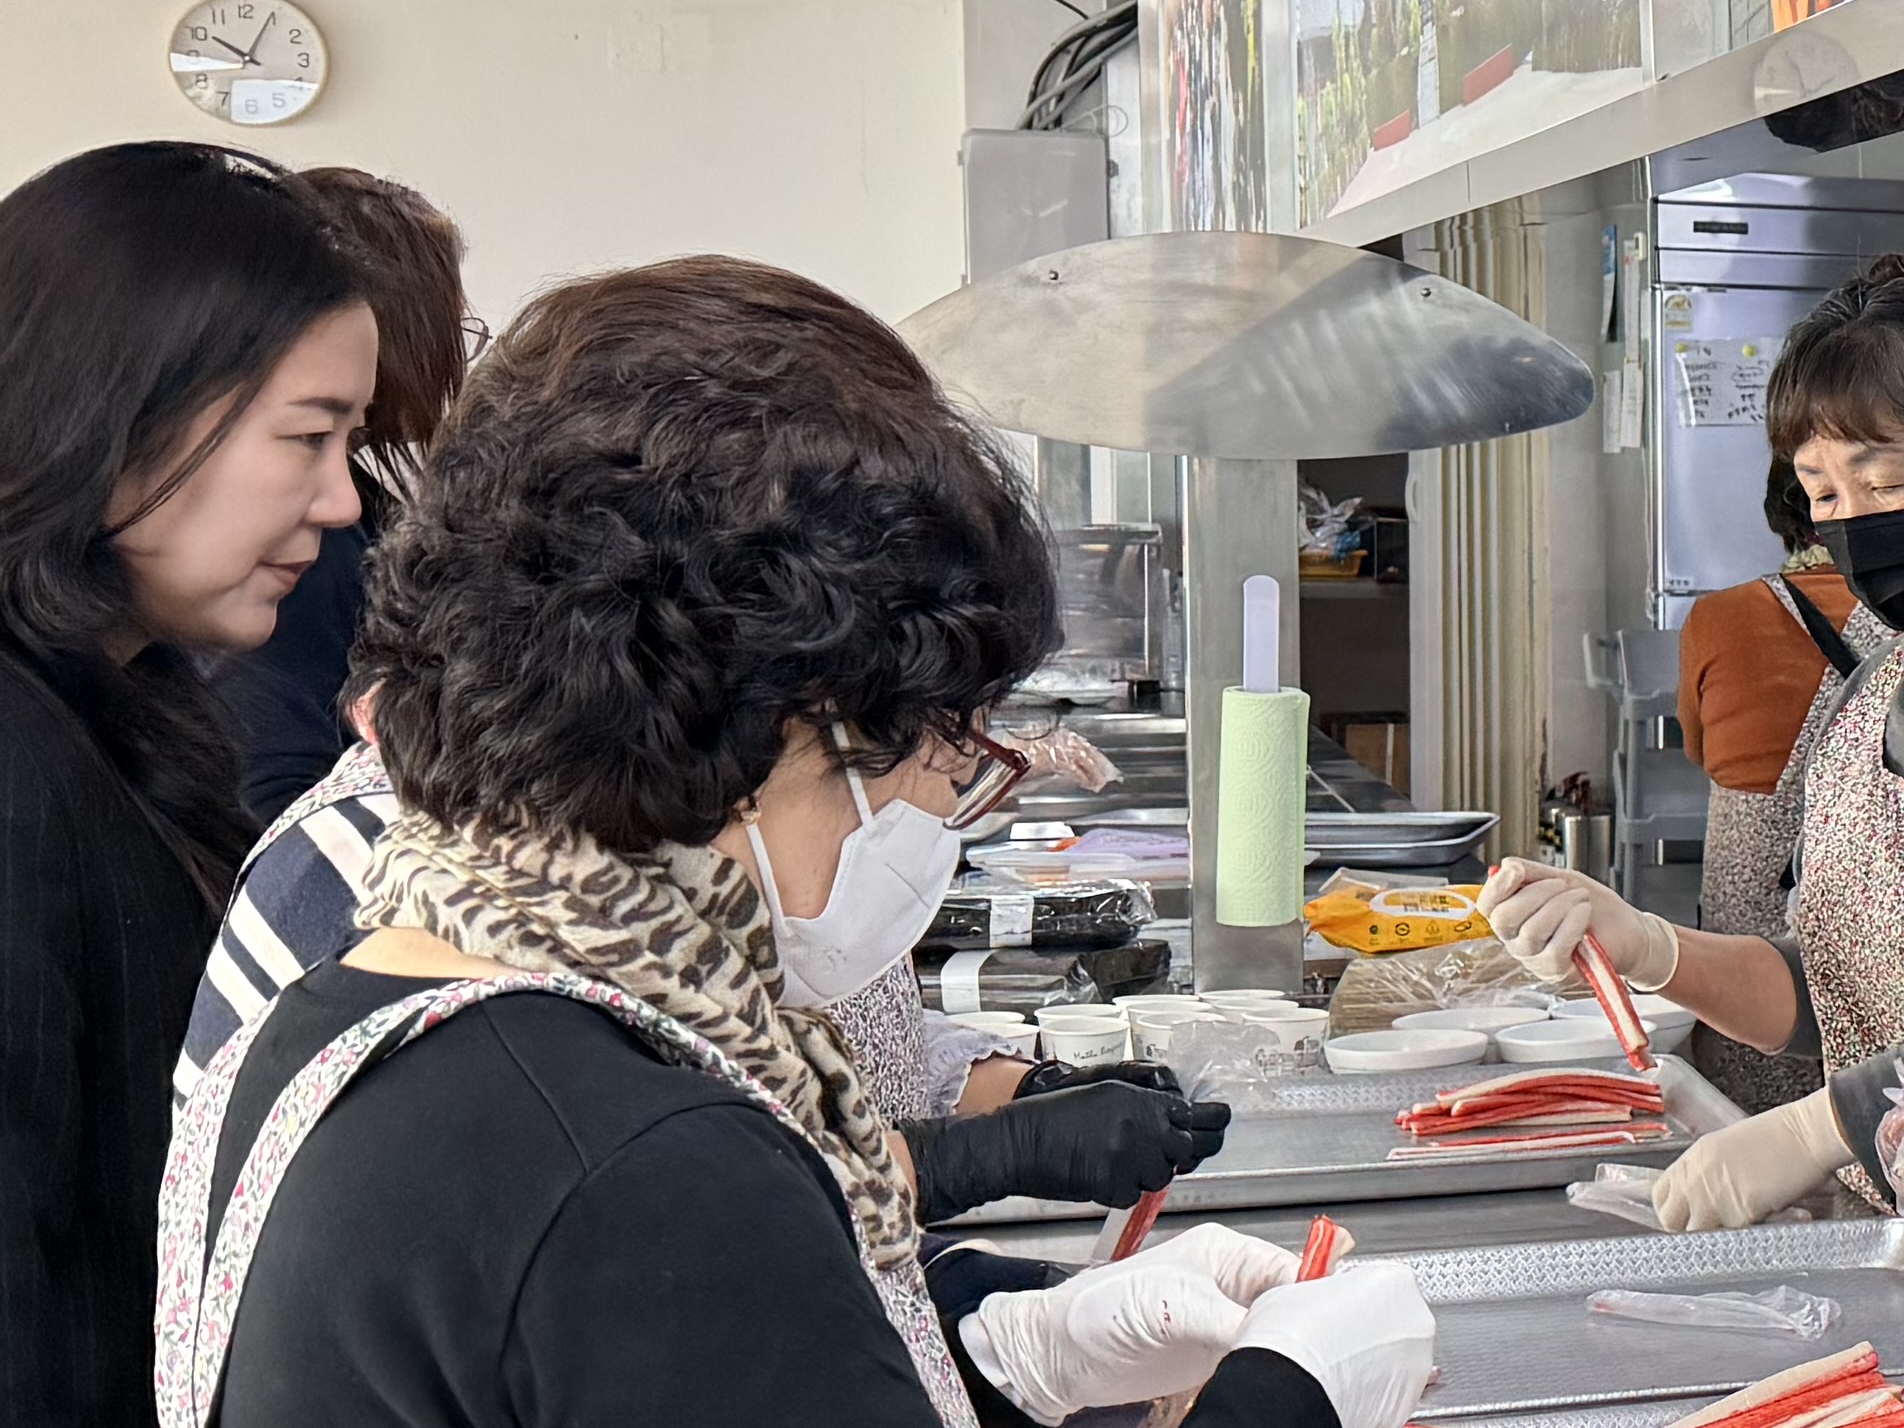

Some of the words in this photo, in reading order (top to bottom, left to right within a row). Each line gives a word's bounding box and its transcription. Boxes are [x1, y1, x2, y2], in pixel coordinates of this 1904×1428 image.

[212, 9, 225, 25] 11
[238, 4, 254, 19] 12
[189, 27, 207, 41] 10
[289, 29, 302, 44] 2
[297, 52, 310, 67] 3
[195, 74, 208, 89] 8
[215, 91, 229, 107] 7
[245, 99, 258, 114] 6
[272, 92, 286, 108] 5
